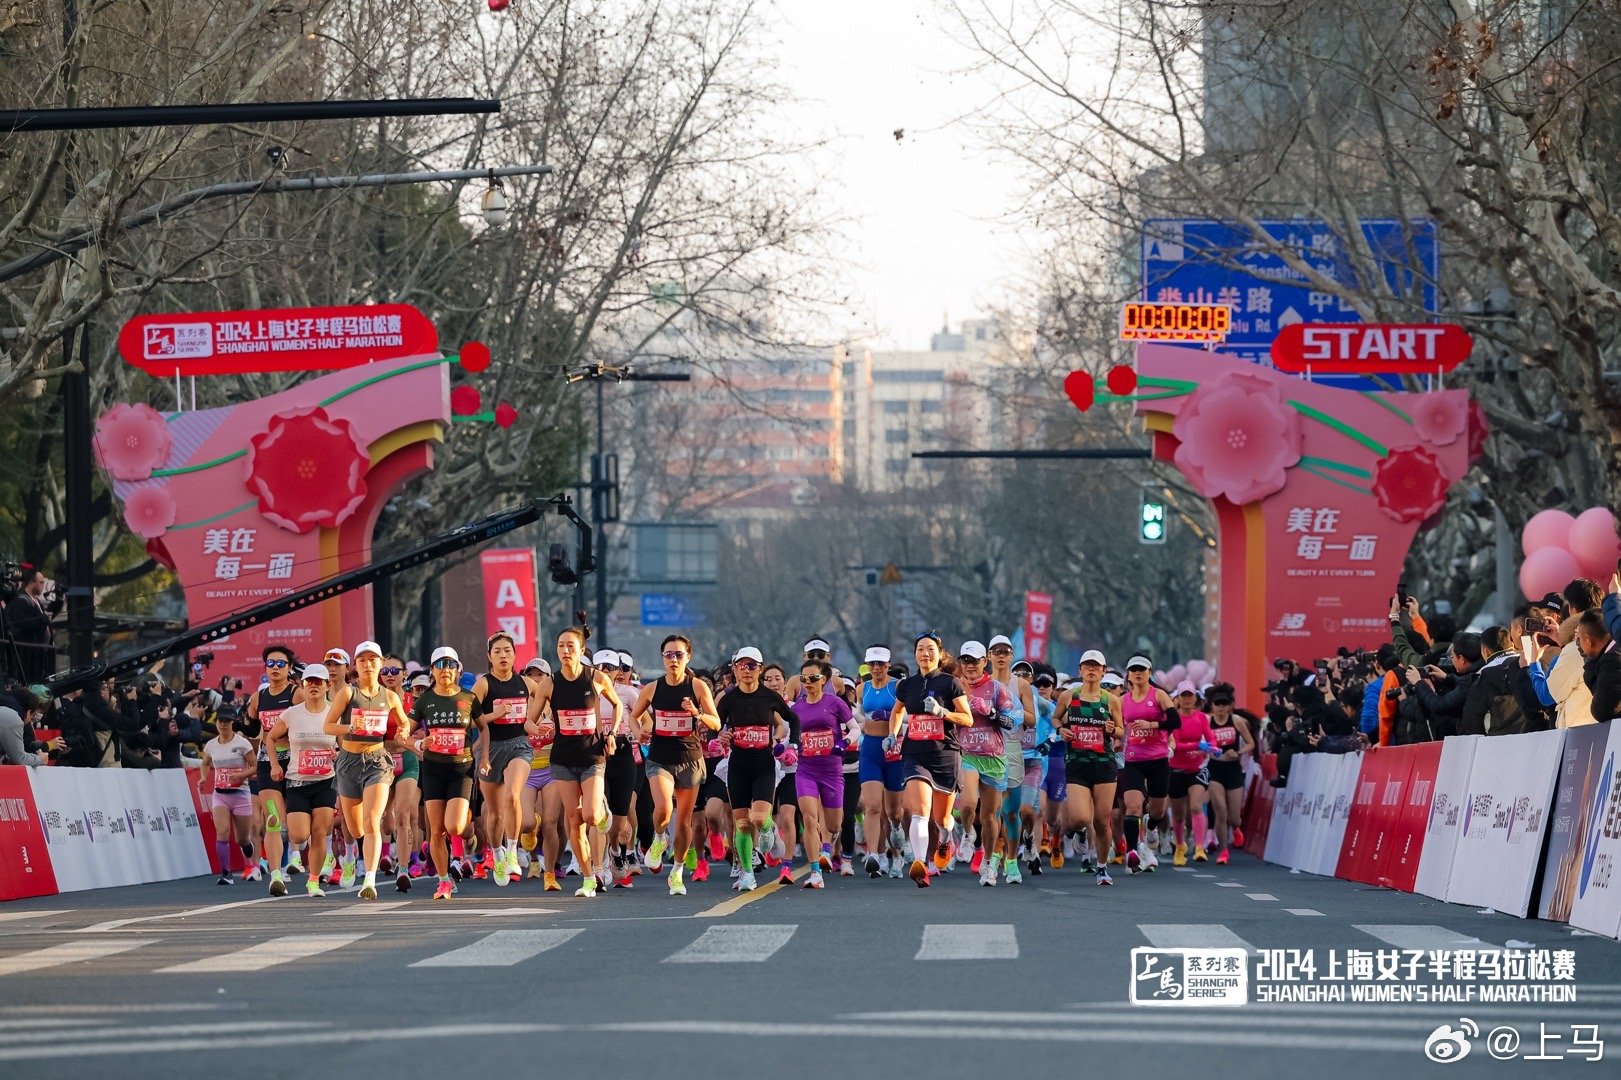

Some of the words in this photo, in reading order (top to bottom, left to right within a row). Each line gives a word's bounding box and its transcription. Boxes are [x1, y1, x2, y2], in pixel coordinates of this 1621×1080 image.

[216, 314, 402, 342] 2024上海女子半程马拉松赛
[1124, 304, 1229, 331] 00:00:08
[217, 341, 269, 354] SHANGHAI
[270, 338, 317, 351] WOMEN'S
[317, 337, 343, 349] HALF
[345, 335, 402, 347] MARATHON
[1302, 328, 1445, 360] START
[1286, 507, 1341, 533] 美在
[203, 528, 257, 554] 美在
[1297, 534, 1378, 561] 每一面
[215, 553, 295, 580] 每一面
[1287, 569, 1318, 577] BEAUTY
[206, 590, 236, 598] BEAUTY
[237, 589, 248, 597] AT
[249, 589, 272, 597] EVERY
[910, 722, 938, 733] A2041
[1068, 715, 1090, 725] Kenya
[1091, 717, 1109, 725] Spee
[803, 736, 829, 749] A3763
[962, 733, 990, 744] A2794
